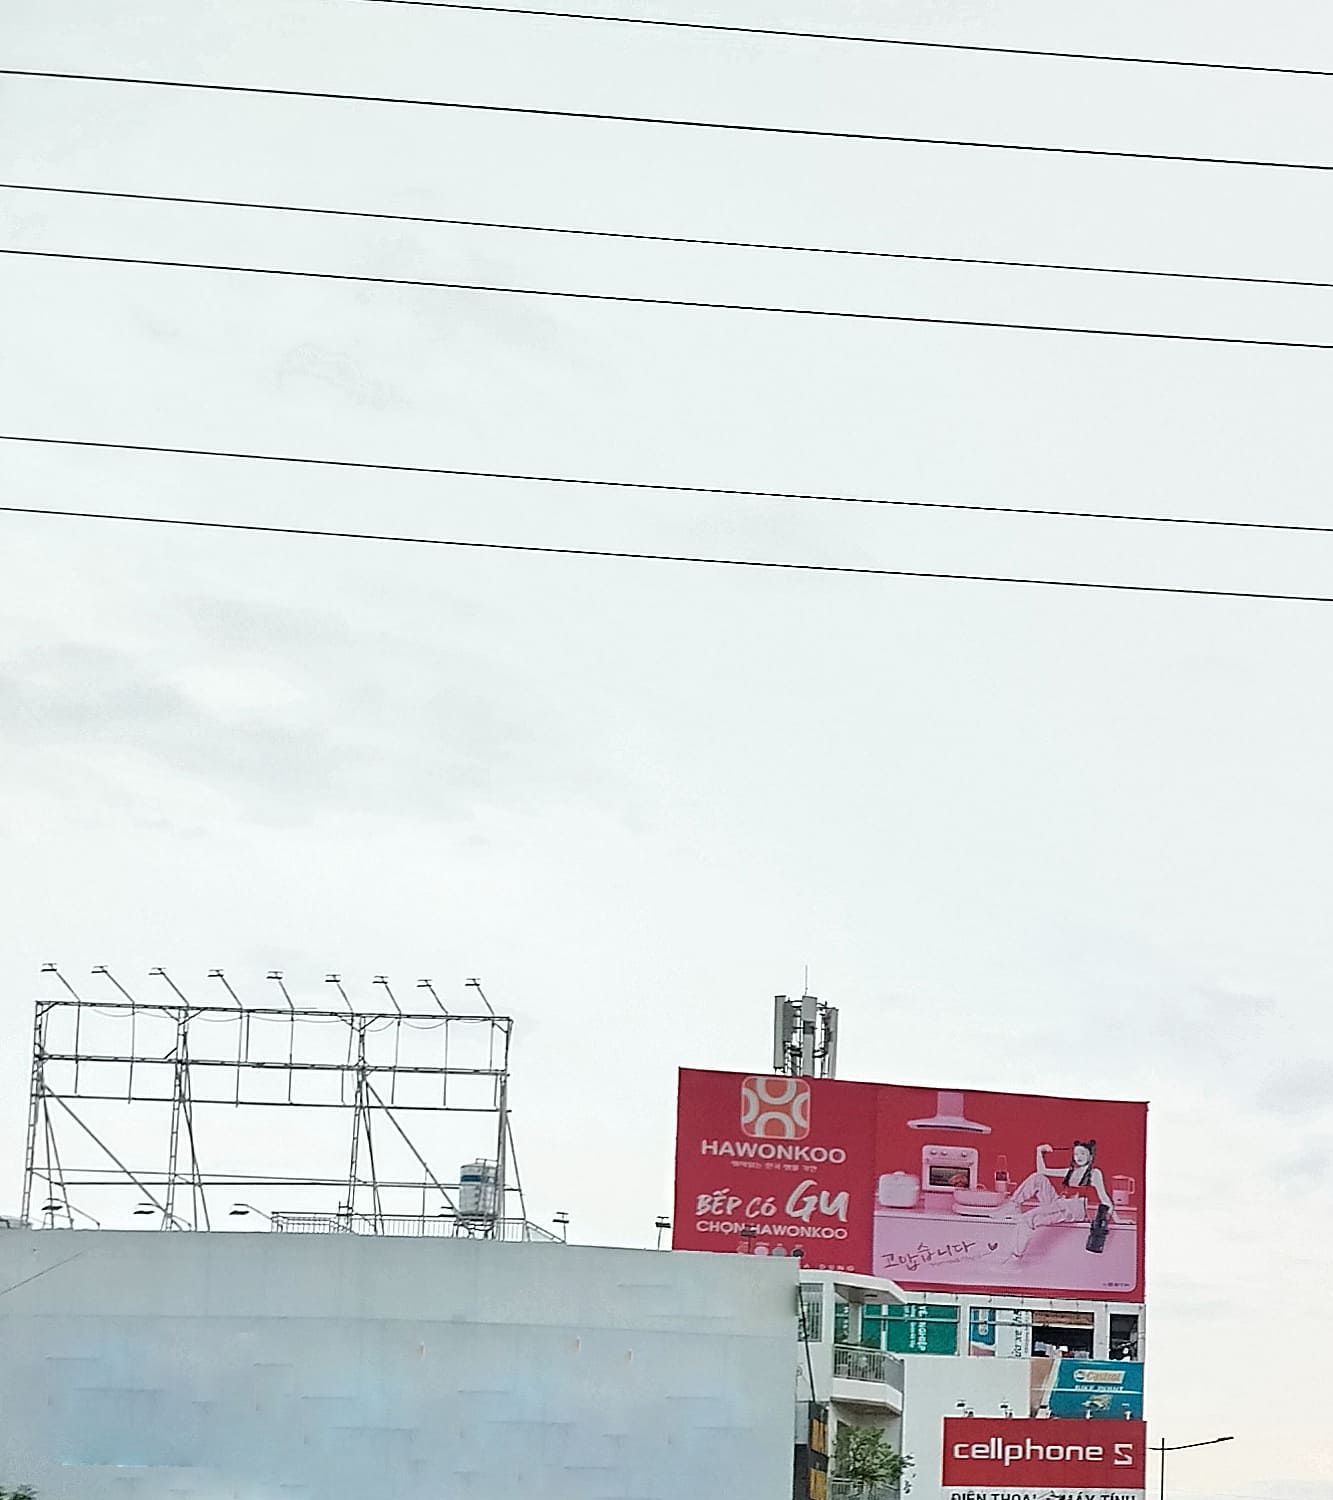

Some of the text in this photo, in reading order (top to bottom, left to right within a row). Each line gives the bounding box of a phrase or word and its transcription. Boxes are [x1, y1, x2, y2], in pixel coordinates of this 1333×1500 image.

[700, 1139, 847, 1164] HAWONKOO
[696, 1188, 742, 1215] BẾP
[752, 1225, 848, 1240] HAWONKOO
[953, 1438, 1104, 1466] cellphone
